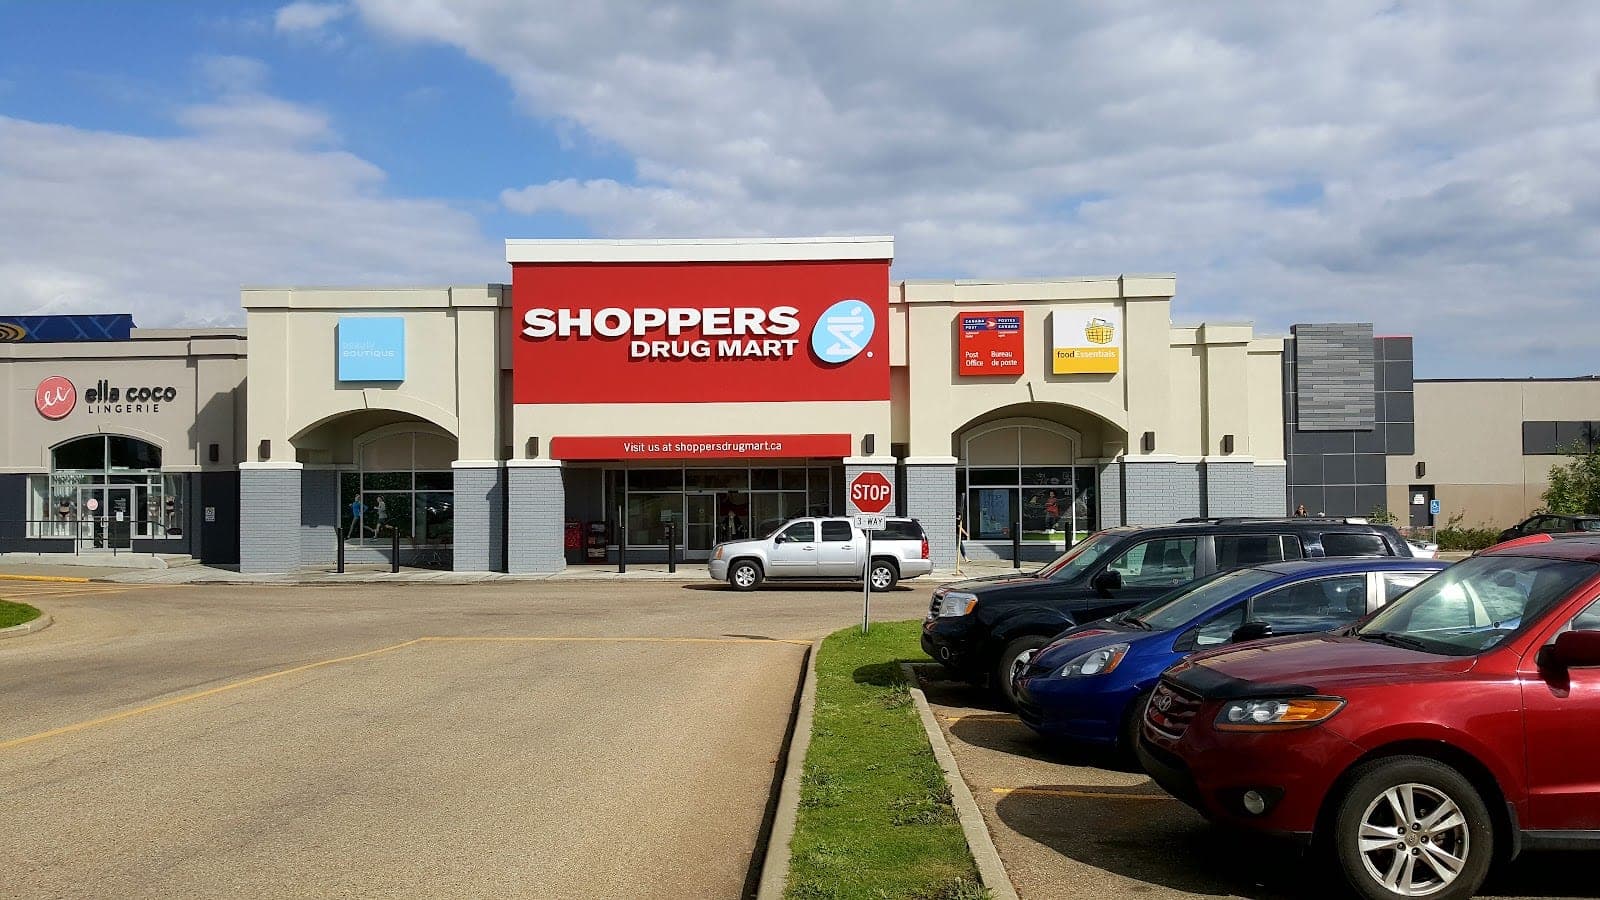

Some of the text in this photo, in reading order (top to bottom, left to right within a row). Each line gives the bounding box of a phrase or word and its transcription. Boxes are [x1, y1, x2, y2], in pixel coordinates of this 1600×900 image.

[522, 306, 800, 337] SHOPPERS
[631, 339, 799, 358] DRUG MART
[991, 350, 1013, 358] Bureau
[965, 359, 984, 367] Office
[1001, 359, 1018, 367] poste
[85, 379, 177, 403] ella coco
[88, 404, 160, 414] LINGERIE
[623, 440, 782, 453] Visit us at shoppersdrugmart.ca
[853, 484, 890, 500] STOP
[857, 517, 883, 525] 3 WAY
